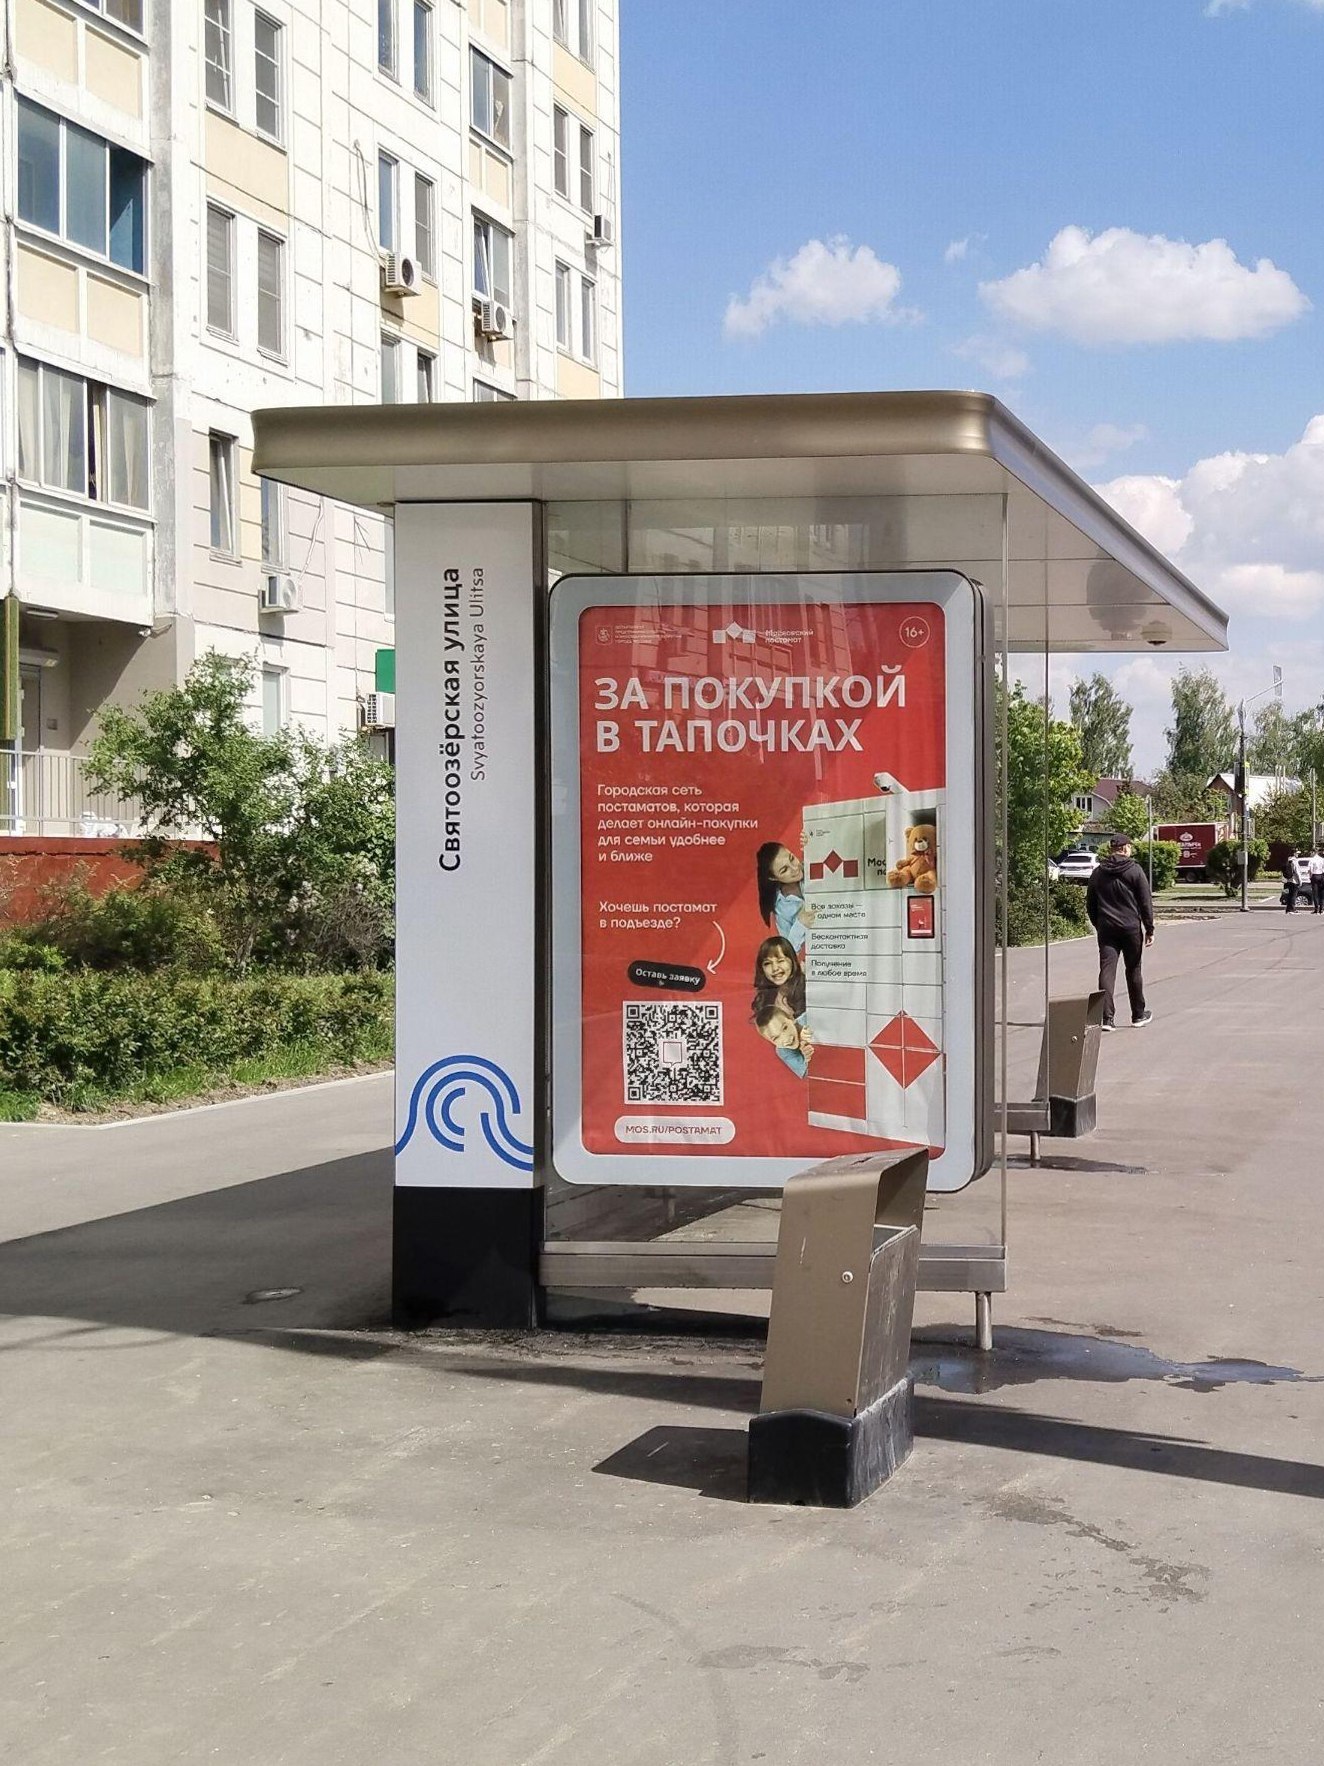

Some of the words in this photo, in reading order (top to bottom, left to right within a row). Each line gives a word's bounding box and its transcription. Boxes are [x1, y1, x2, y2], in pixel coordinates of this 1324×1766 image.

[469, 568, 484, 617] Ulitsa
[444, 568, 465, 651] улица
[904, 627, 925, 638] 16+
[594, 677, 649, 710] ЗА
[664, 664, 906, 710] ПОКУПКОЙ
[470, 624, 488, 781] Svyatoozyorskaya
[596, 720, 620, 753] В
[634, 718, 864, 753] ТАПОЧКАХ
[439, 661, 465, 871] Святоозёрская
[597, 784, 668, 798] Городская
[672, 785, 703, 796] сеть
[597, 802, 681, 815] постаматов,
[684, 802, 739, 815] которая
[597, 819, 644, 831] делает
[647, 816, 758, 832] онлайн-покупки
[598, 836, 621, 847] для
[624, 835, 666, 846] семьи
[669, 833, 726, 848] удобнее
[598, 853, 607, 862] и
[610, 849, 653, 862] ближе
[867, 857, 886, 867] Мос
[599, 901, 650, 913] Хочешь
[653, 903, 718, 913] постамат
[599, 918, 607, 928] в
[611, 916, 681, 929] подъезде?
[811, 942, 846, 950] доставка
[811, 959, 852, 968] Получение
[635, 968, 667, 980] Оставь
[669, 973, 701, 986] заявку
[625, 1125, 722, 1135] MOS.RU/POSTAMAT
